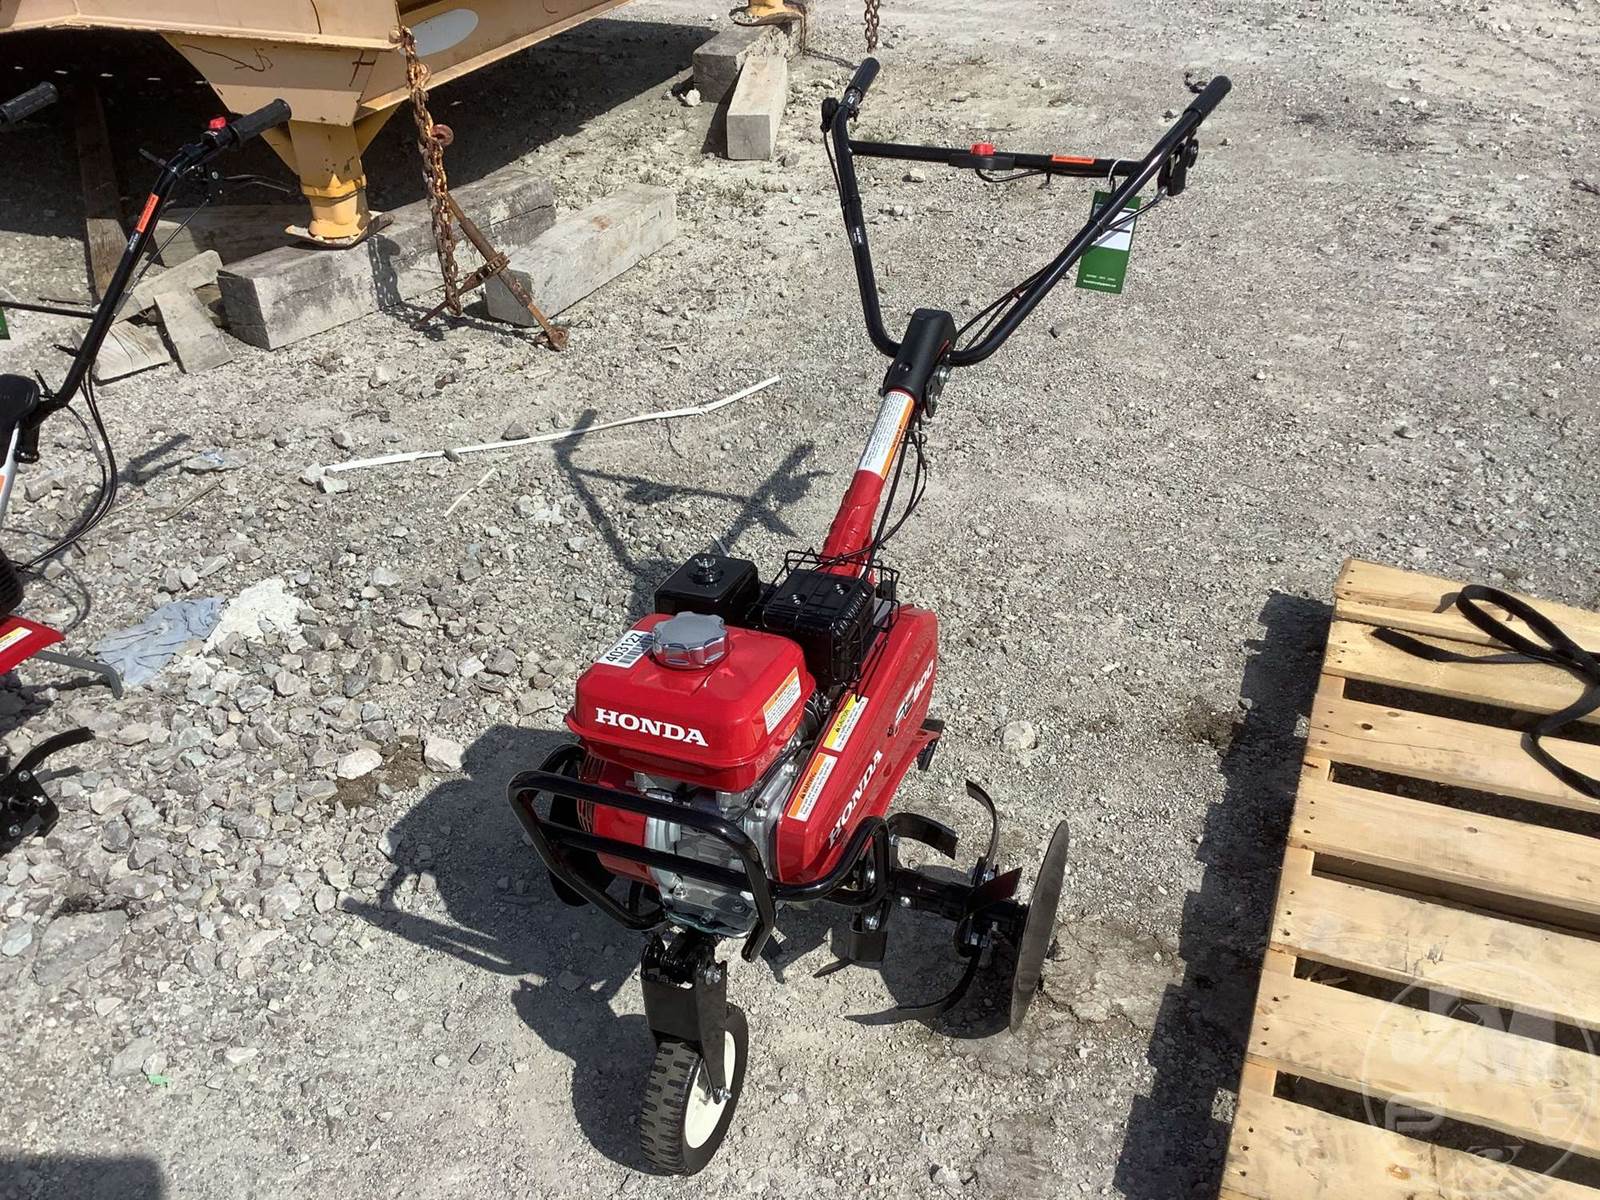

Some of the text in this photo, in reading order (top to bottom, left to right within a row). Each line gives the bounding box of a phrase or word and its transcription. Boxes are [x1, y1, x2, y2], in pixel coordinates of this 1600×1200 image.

[605, 632, 643, 662] 403127
[595, 707, 709, 747] HONDA
[828, 750, 883, 849] HONDA
